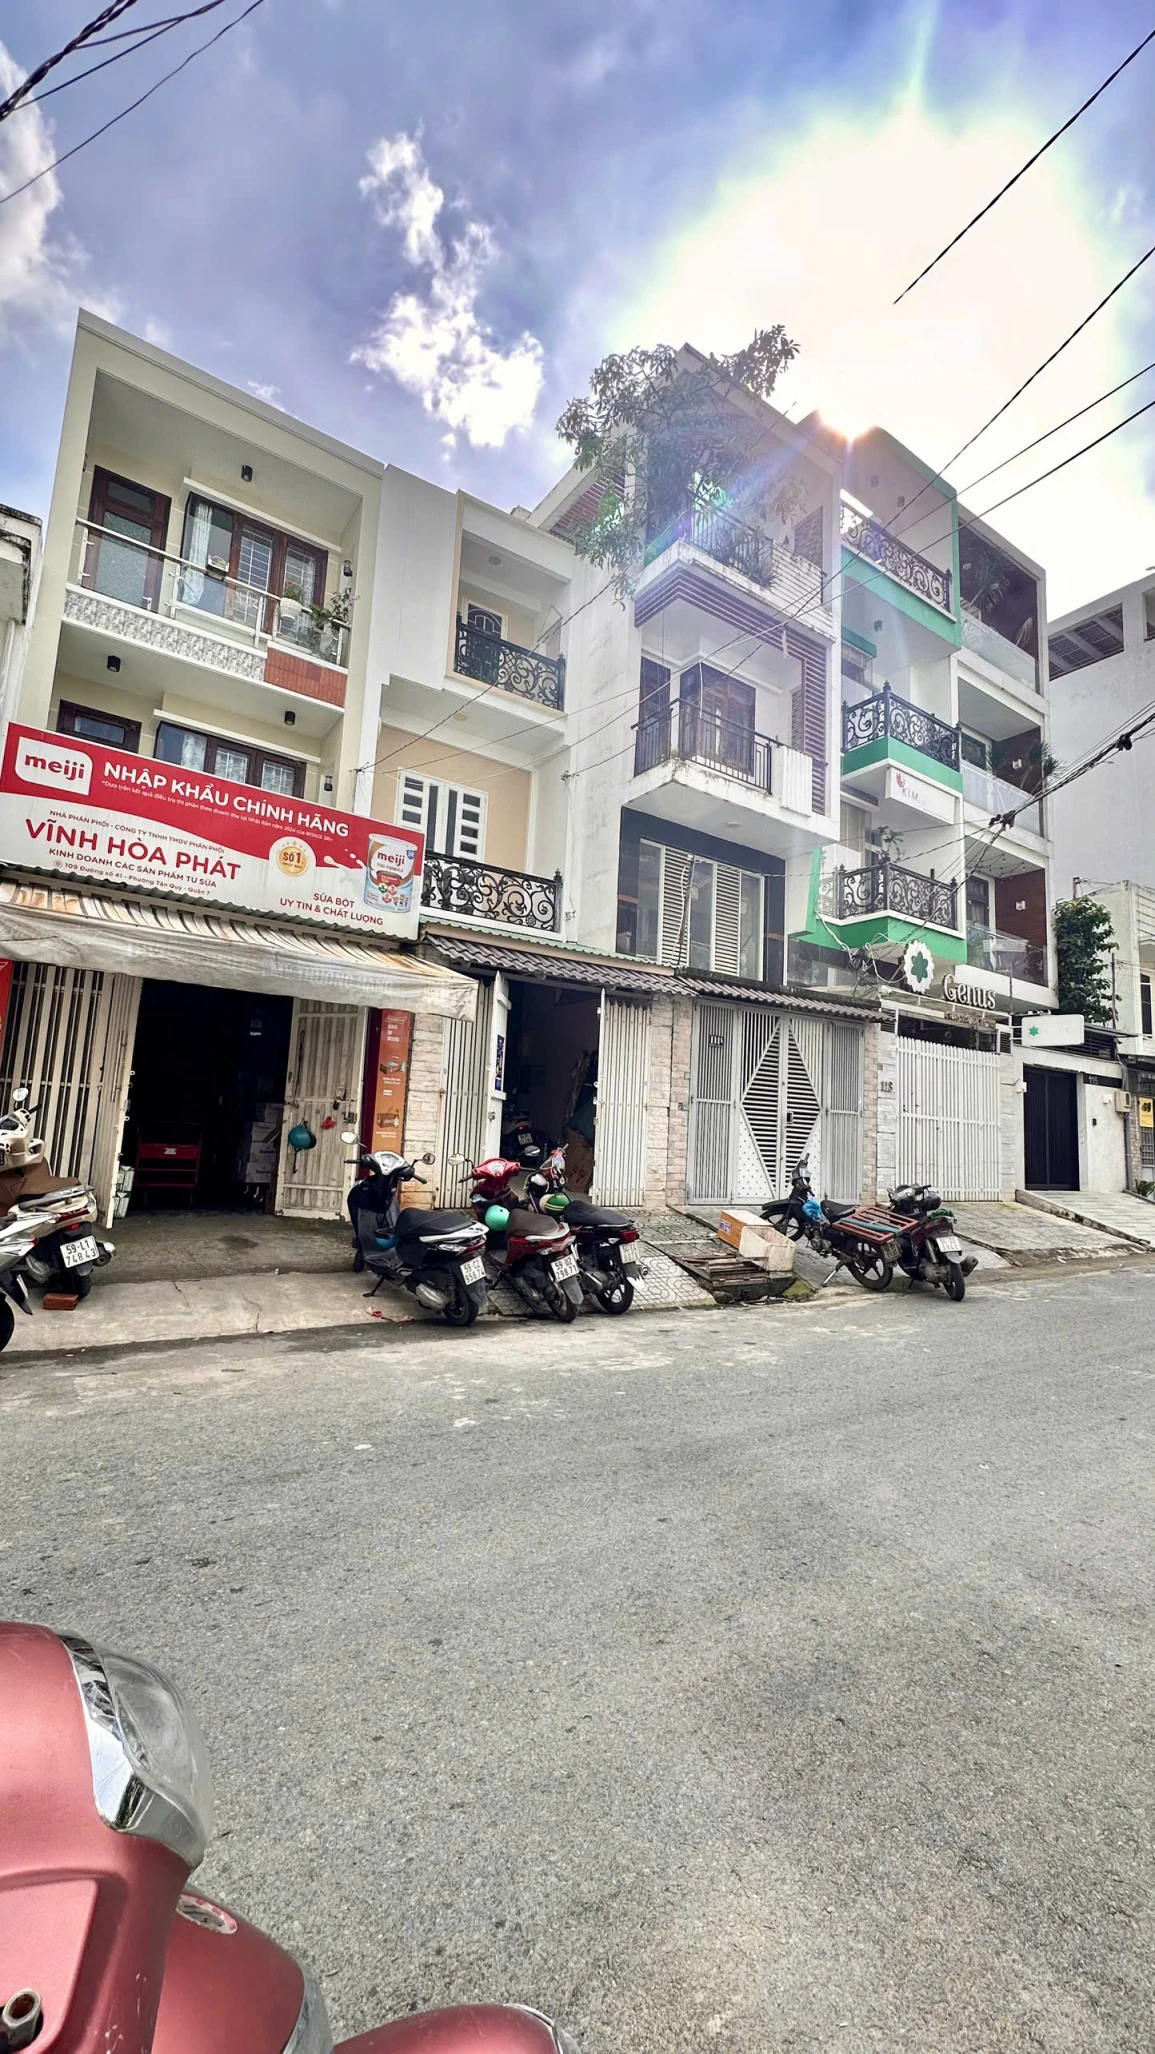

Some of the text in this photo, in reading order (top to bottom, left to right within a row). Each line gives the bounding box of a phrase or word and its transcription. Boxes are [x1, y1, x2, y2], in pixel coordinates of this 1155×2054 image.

[24, 754, 85, 780] meiji
[104, 761, 349, 837] NHẬP KHẨU CHÍNH HÃNG
[114, 824, 137, 834] CÔNG
[138, 829, 147, 837] TY
[149, 832, 168, 841] TNHH
[169, 836, 188, 845] TMDV
[25, 818, 241, 879] VĨNH HÒA PHÁT
[377, 852, 405, 866] meiji
[49, 848, 74, 859] KINH
[76, 853, 113, 867] DOANH
[115, 860, 135, 871] CÁC
[137, 864, 156, 875] SẢN
[158, 868, 184, 881] PHẨM
[65, 862, 78, 870] 109
[280, 897, 384, 926] UY TÍN & CHẤT LƯỢNG
[313, 891, 332, 905] SỮA
[335, 896, 355, 909] BỘT
[943, 973, 996, 1010] Genus
[66, 1240, 90, 1254] 59-L1
